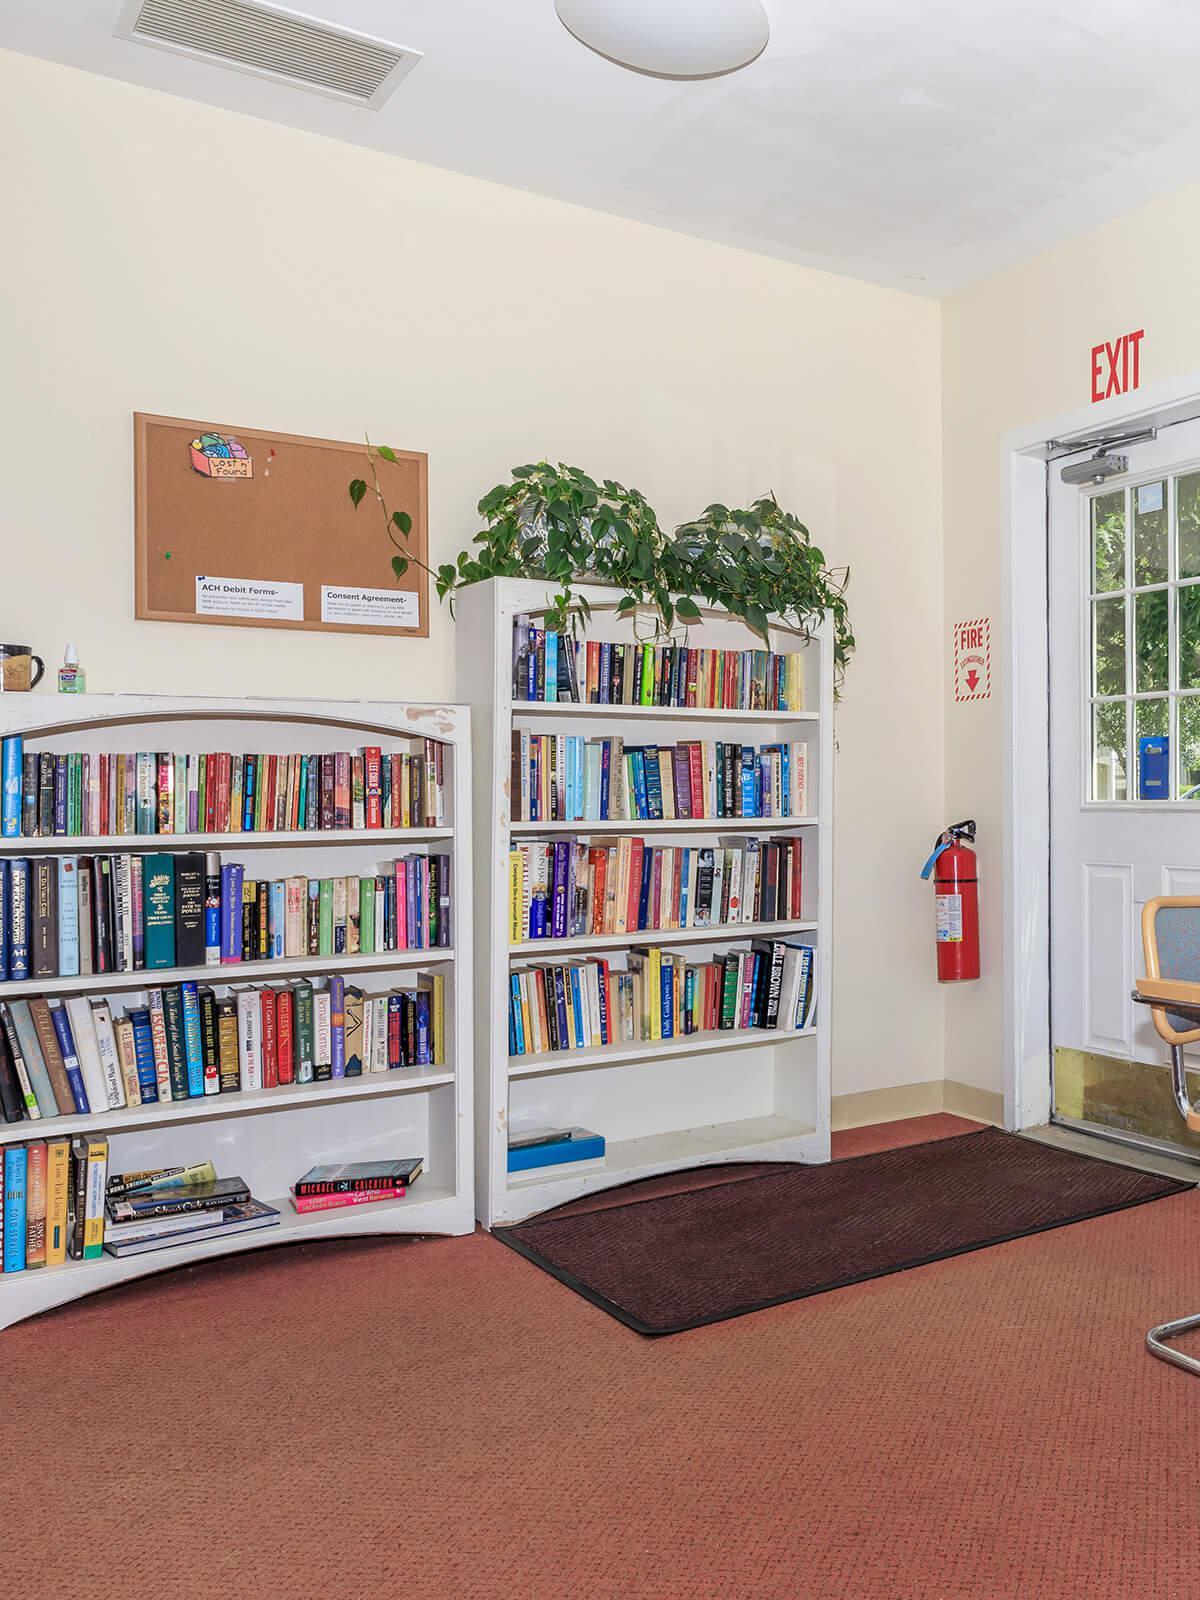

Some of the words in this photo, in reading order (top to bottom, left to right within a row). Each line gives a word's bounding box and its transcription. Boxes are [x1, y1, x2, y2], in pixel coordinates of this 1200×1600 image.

[1092, 329, 1144, 403] EXIT
[223, 586, 246, 594] Debit
[327, 592, 359, 600] Consent
[961, 627, 983, 649] FIRE
[773, 944, 785, 965] DALE
[769, 966, 782, 998] BROWN
[169, 1008, 177, 1024] Tales
[265, 1010, 273, 1023] Can't
[35, 1007, 50, 1033] FULL
[43, 1035, 60, 1066] CIRCLE
[152, 1013, 165, 1045] ESCAPE
[172, 1043, 180, 1061] South
[157, 1061, 169, 1085] CIA
[173, 1062, 183, 1083] Pacific
[55, 1163, 64, 1194] Low-Fat
[301, 1183, 334, 1194] MICHAEL
[355, 1178, 392, 1190] CRICHTON
[10, 1208, 18, 1227] COLD
[53, 1197, 63, 1222] Living
[28, 1225, 37, 1254] FATHER
[36, 1223, 45, 1237] SINS
[10, 1229, 18, 1257] SERVICE
[36, 1239, 43, 1249] OF
